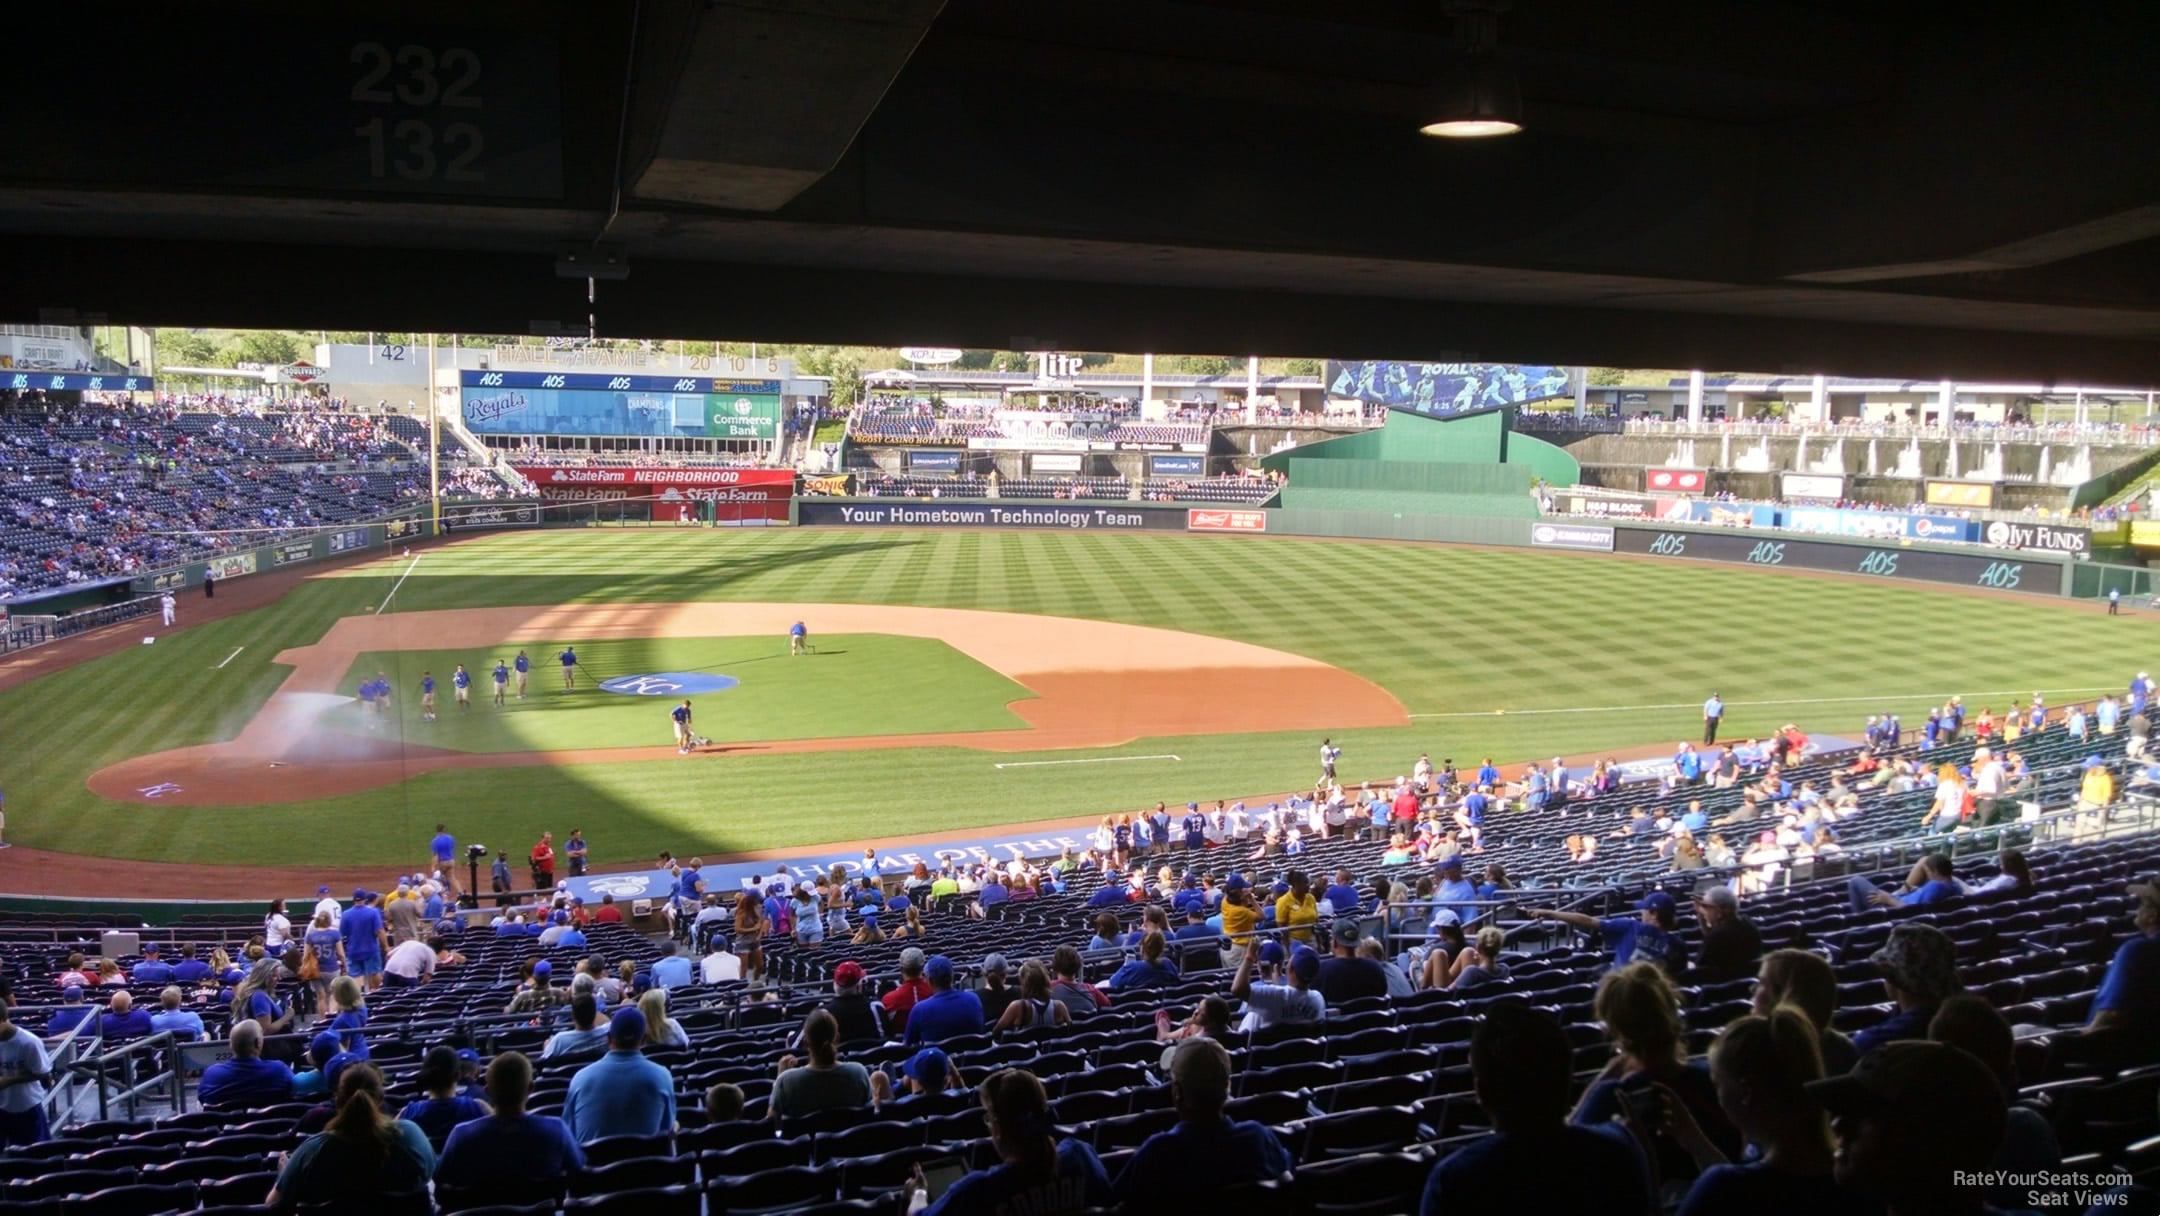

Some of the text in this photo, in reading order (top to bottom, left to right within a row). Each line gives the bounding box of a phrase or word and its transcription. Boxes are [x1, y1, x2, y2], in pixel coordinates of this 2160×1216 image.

[350, 41, 482, 109] 232
[355, 116, 485, 183] 132
[381, 345, 405, 361] 42
[495, 343, 560, 364] HALL
[582, 347, 647, 368] FAME
[690, 356, 711, 371] 20
[728, 357, 746, 371] 10
[768, 359, 779, 373] 5
[12, 374, 28, 388] AOS
[50, 375, 65, 390] AOS
[89, 377, 103, 390] AOS
[124, 378, 138, 391] AOS
[480, 373, 503, 386] AOS
[542, 375, 565, 388] AOS
[608, 377, 631, 389] AOS
[673, 379, 696, 391] AOS
[467, 391, 526, 421] Royals
[713, 414, 773, 425] Commerce
[729, 424, 758, 436] Bank
[885, 436, 914, 445] CASINO
[916, 436, 940, 445] HOTEL
[952, 436, 966, 445] SPA
[634, 471, 739, 483] NEIGHBORHOOD
[804, 479, 846, 491] SONIC
[1608, 503, 1644, 512] BLOCK
[841, 507, 1143, 529] Your Hometown Technology Team
[1931, 522, 1956, 535] pepsi
[1590, 533, 1611, 543] CITY
[1650, 533, 1686, 555] AOS
[1747, 541, 1785, 564] AOS
[1857, 551, 1899, 576] AOS
[1977, 562, 2023, 588] AOS
[1191, 823, 1201, 833] 13
[792, 835, 1081, 879] HOME OF THE
[313, 943, 333, 959] 35
